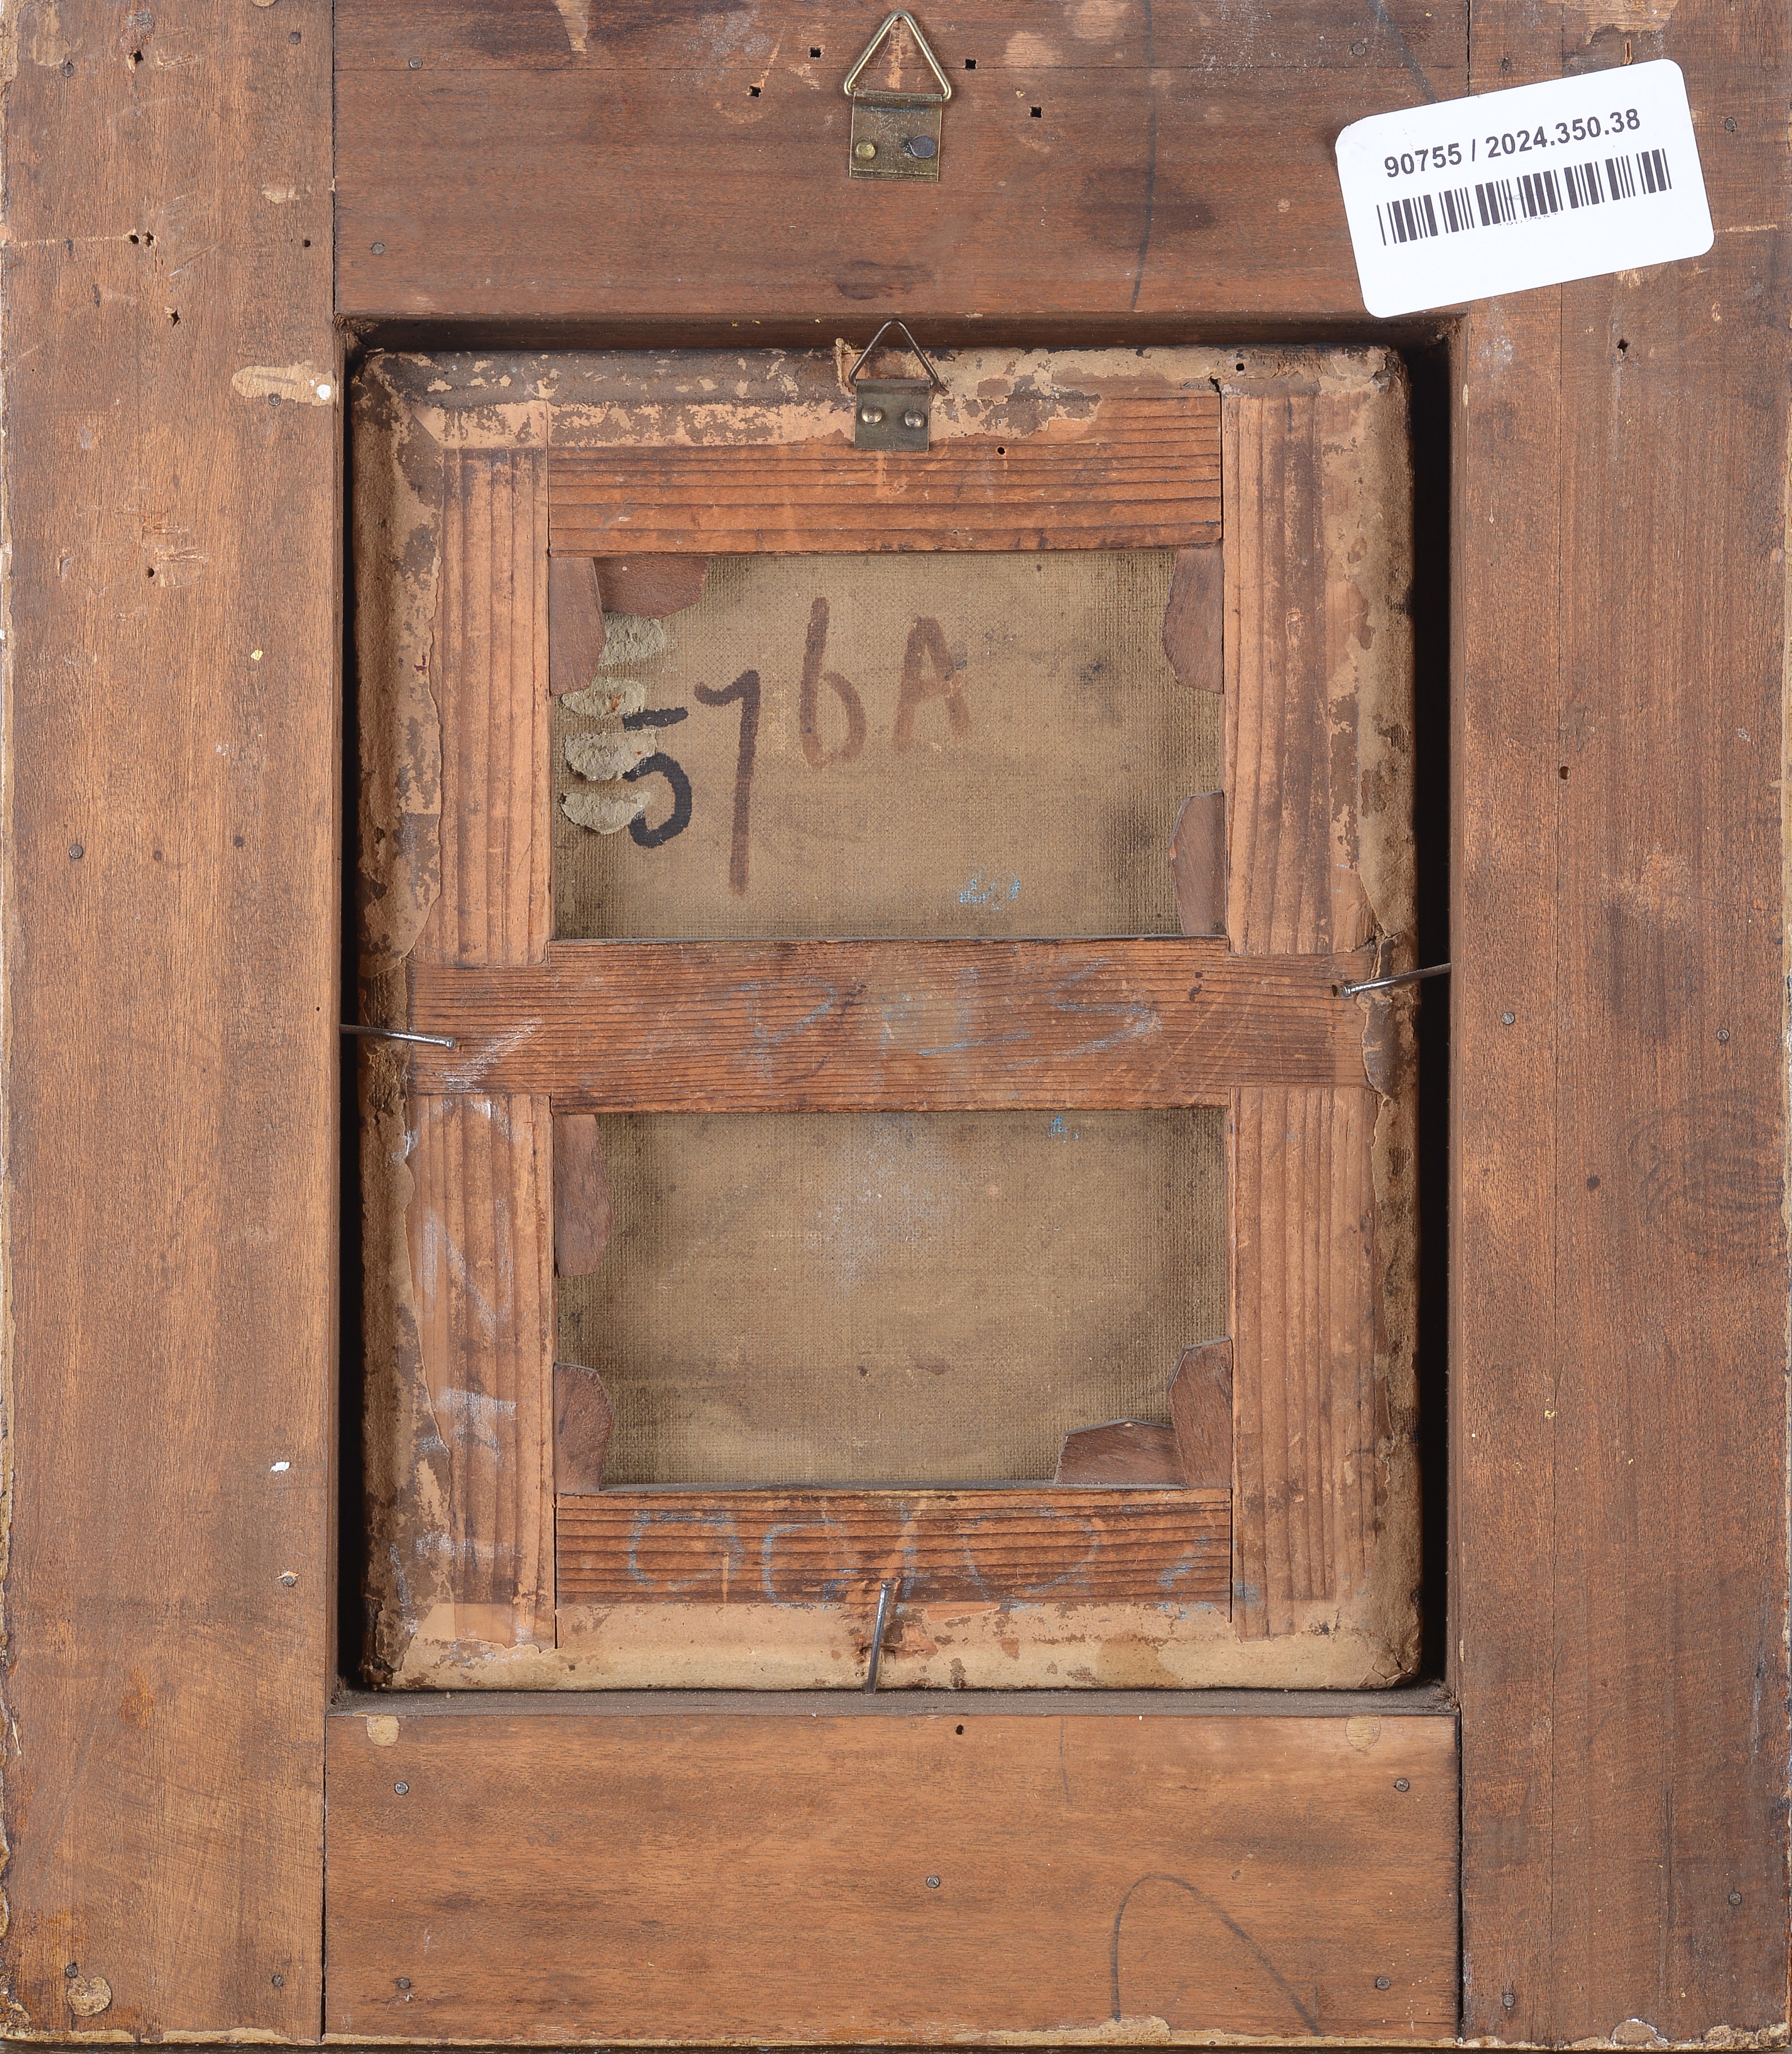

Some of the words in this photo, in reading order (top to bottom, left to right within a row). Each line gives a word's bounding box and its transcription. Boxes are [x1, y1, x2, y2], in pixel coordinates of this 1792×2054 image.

[1384, 143, 1462, 178] 90755
[1471, 139, 1477, 162] /
[1485, 108, 1641, 158] 2024.350.38
